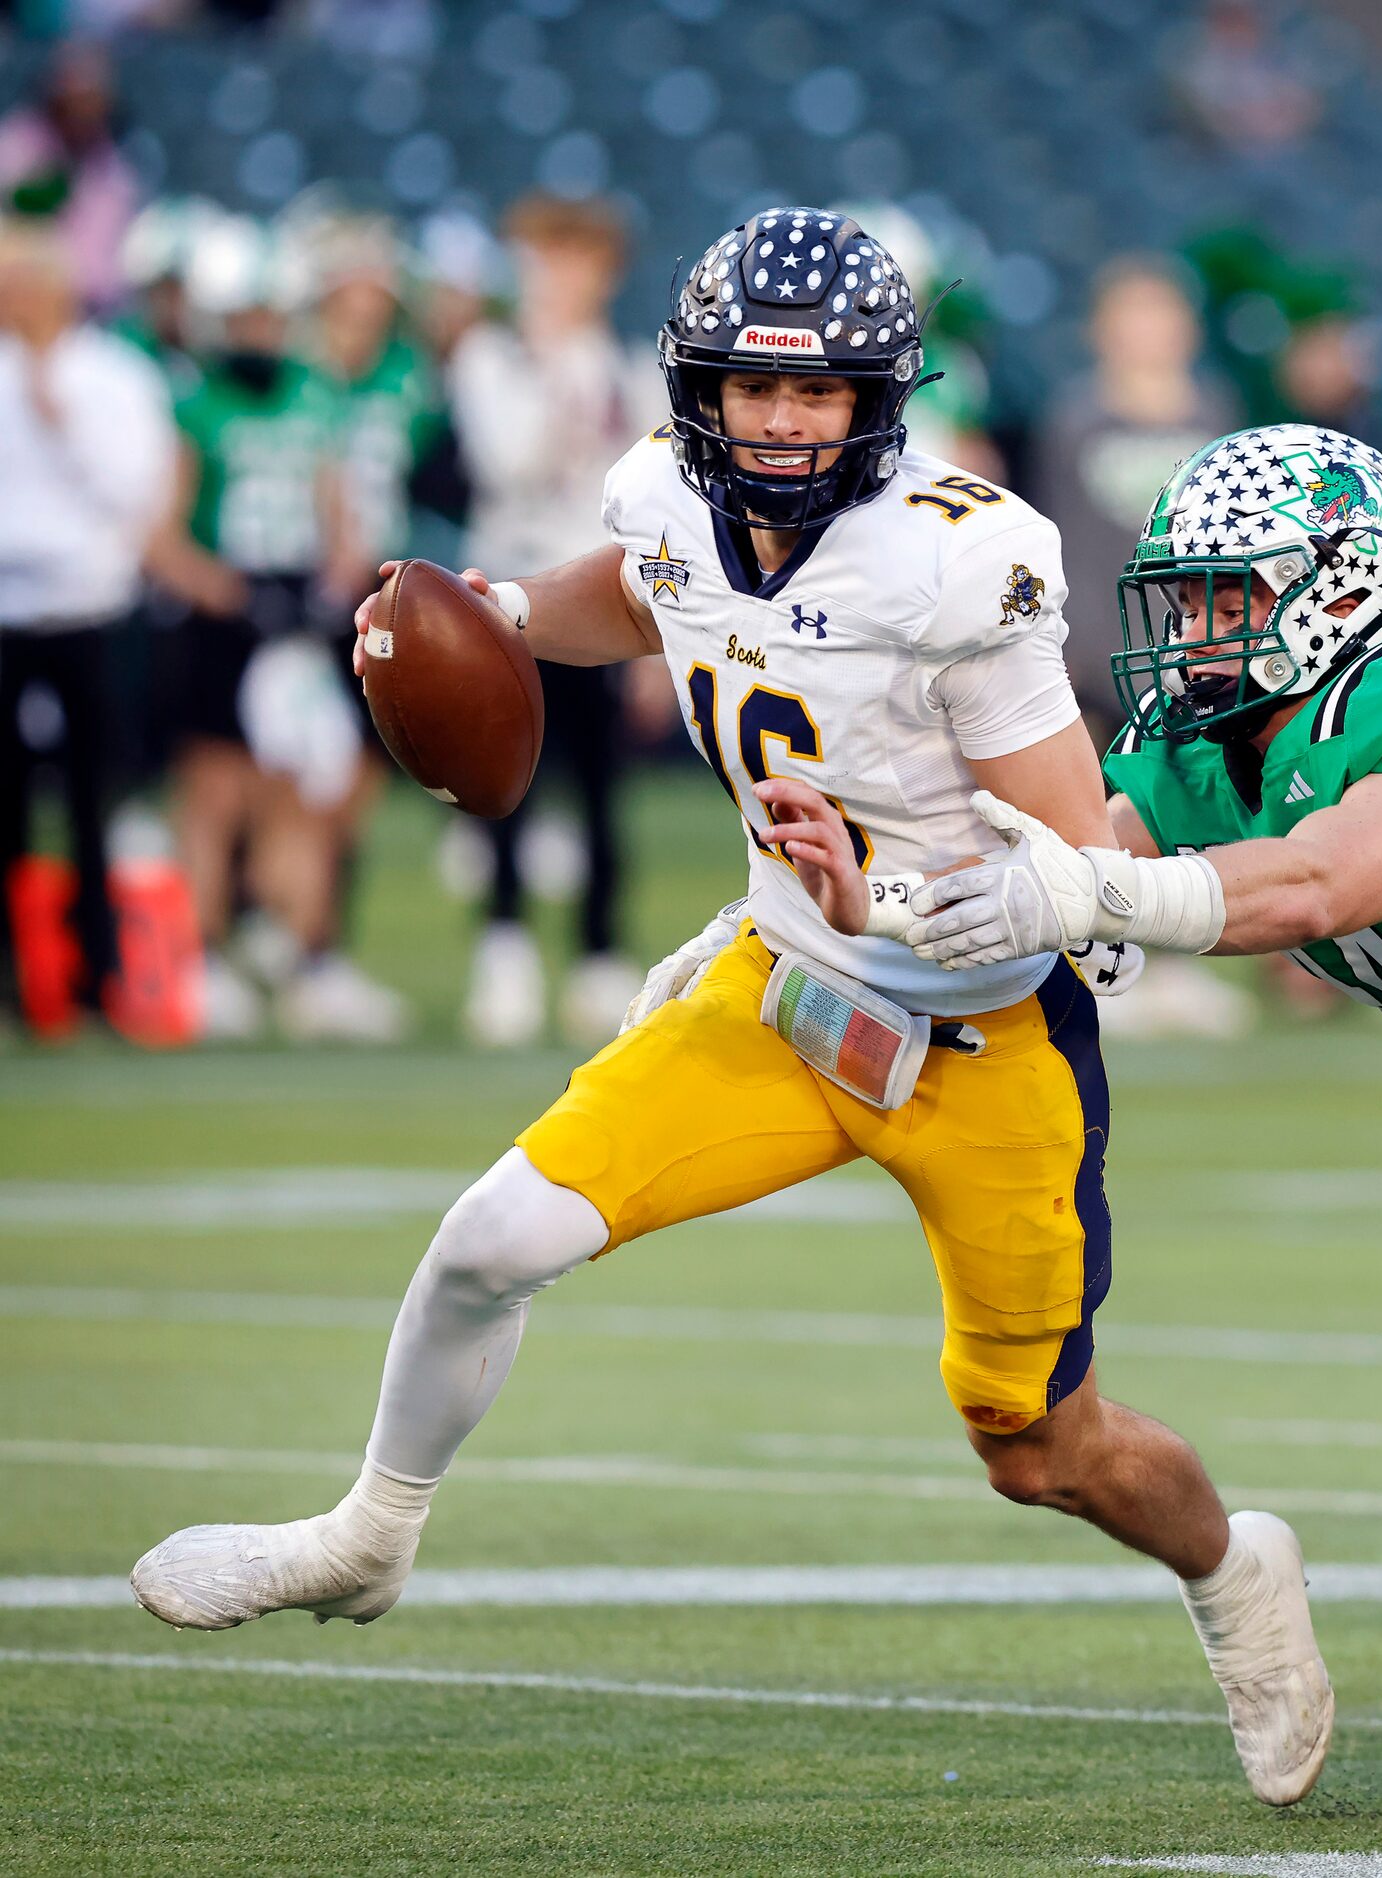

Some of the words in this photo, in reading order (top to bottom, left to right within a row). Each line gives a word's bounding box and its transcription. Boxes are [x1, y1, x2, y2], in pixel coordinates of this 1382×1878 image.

[746, 330, 813, 348] Riddell
[903, 475, 1006, 526] 16
[726, 634, 767, 670] Scots
[687, 660, 875, 877] 16
[1106, 880, 1133, 909] CUTTERS
